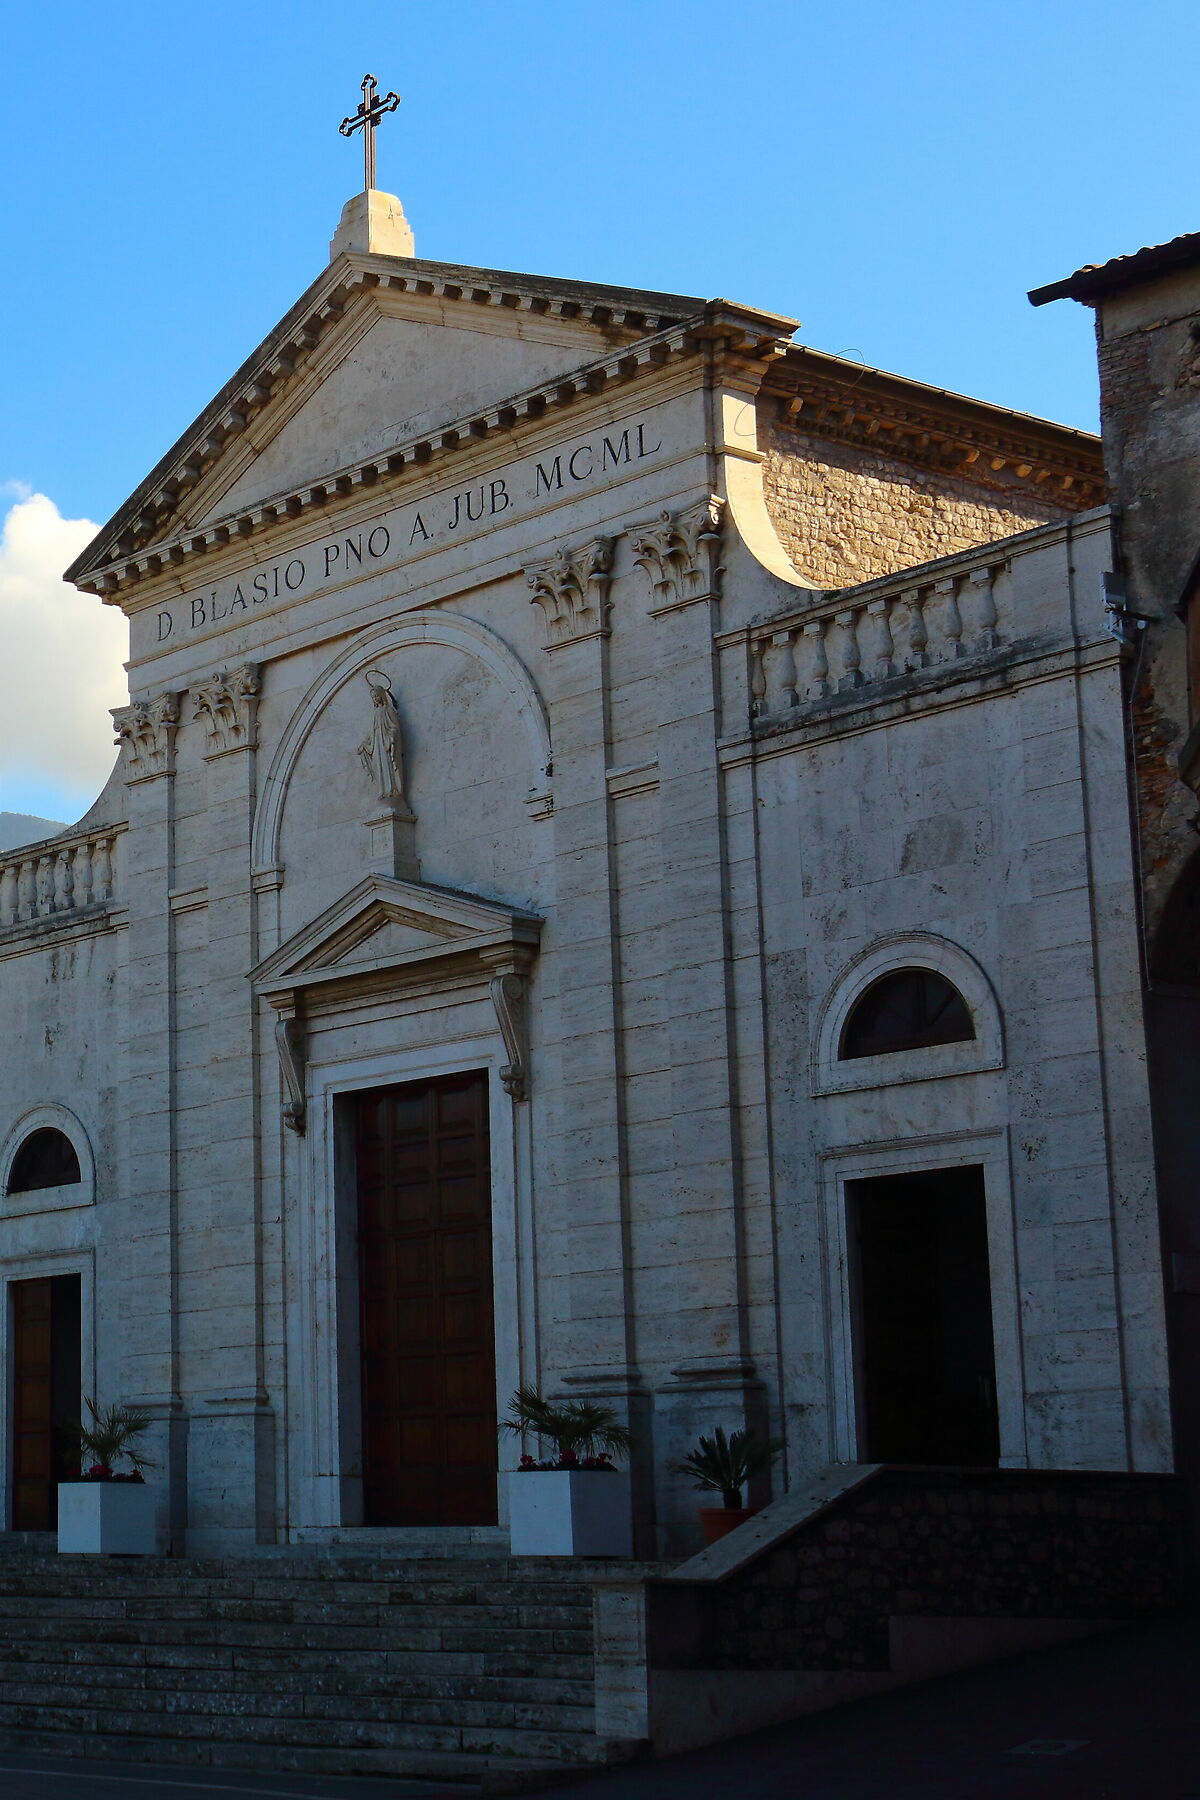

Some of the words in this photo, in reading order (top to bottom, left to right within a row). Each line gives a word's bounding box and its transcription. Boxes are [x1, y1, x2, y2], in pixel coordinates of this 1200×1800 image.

[190, 560, 306, 630] BLASIO
[323, 526, 391, 577] PNO
[408, 512, 434, 545] A.
[448, 479, 514, 529] JUB.
[536, 423, 661, 497] MCML
